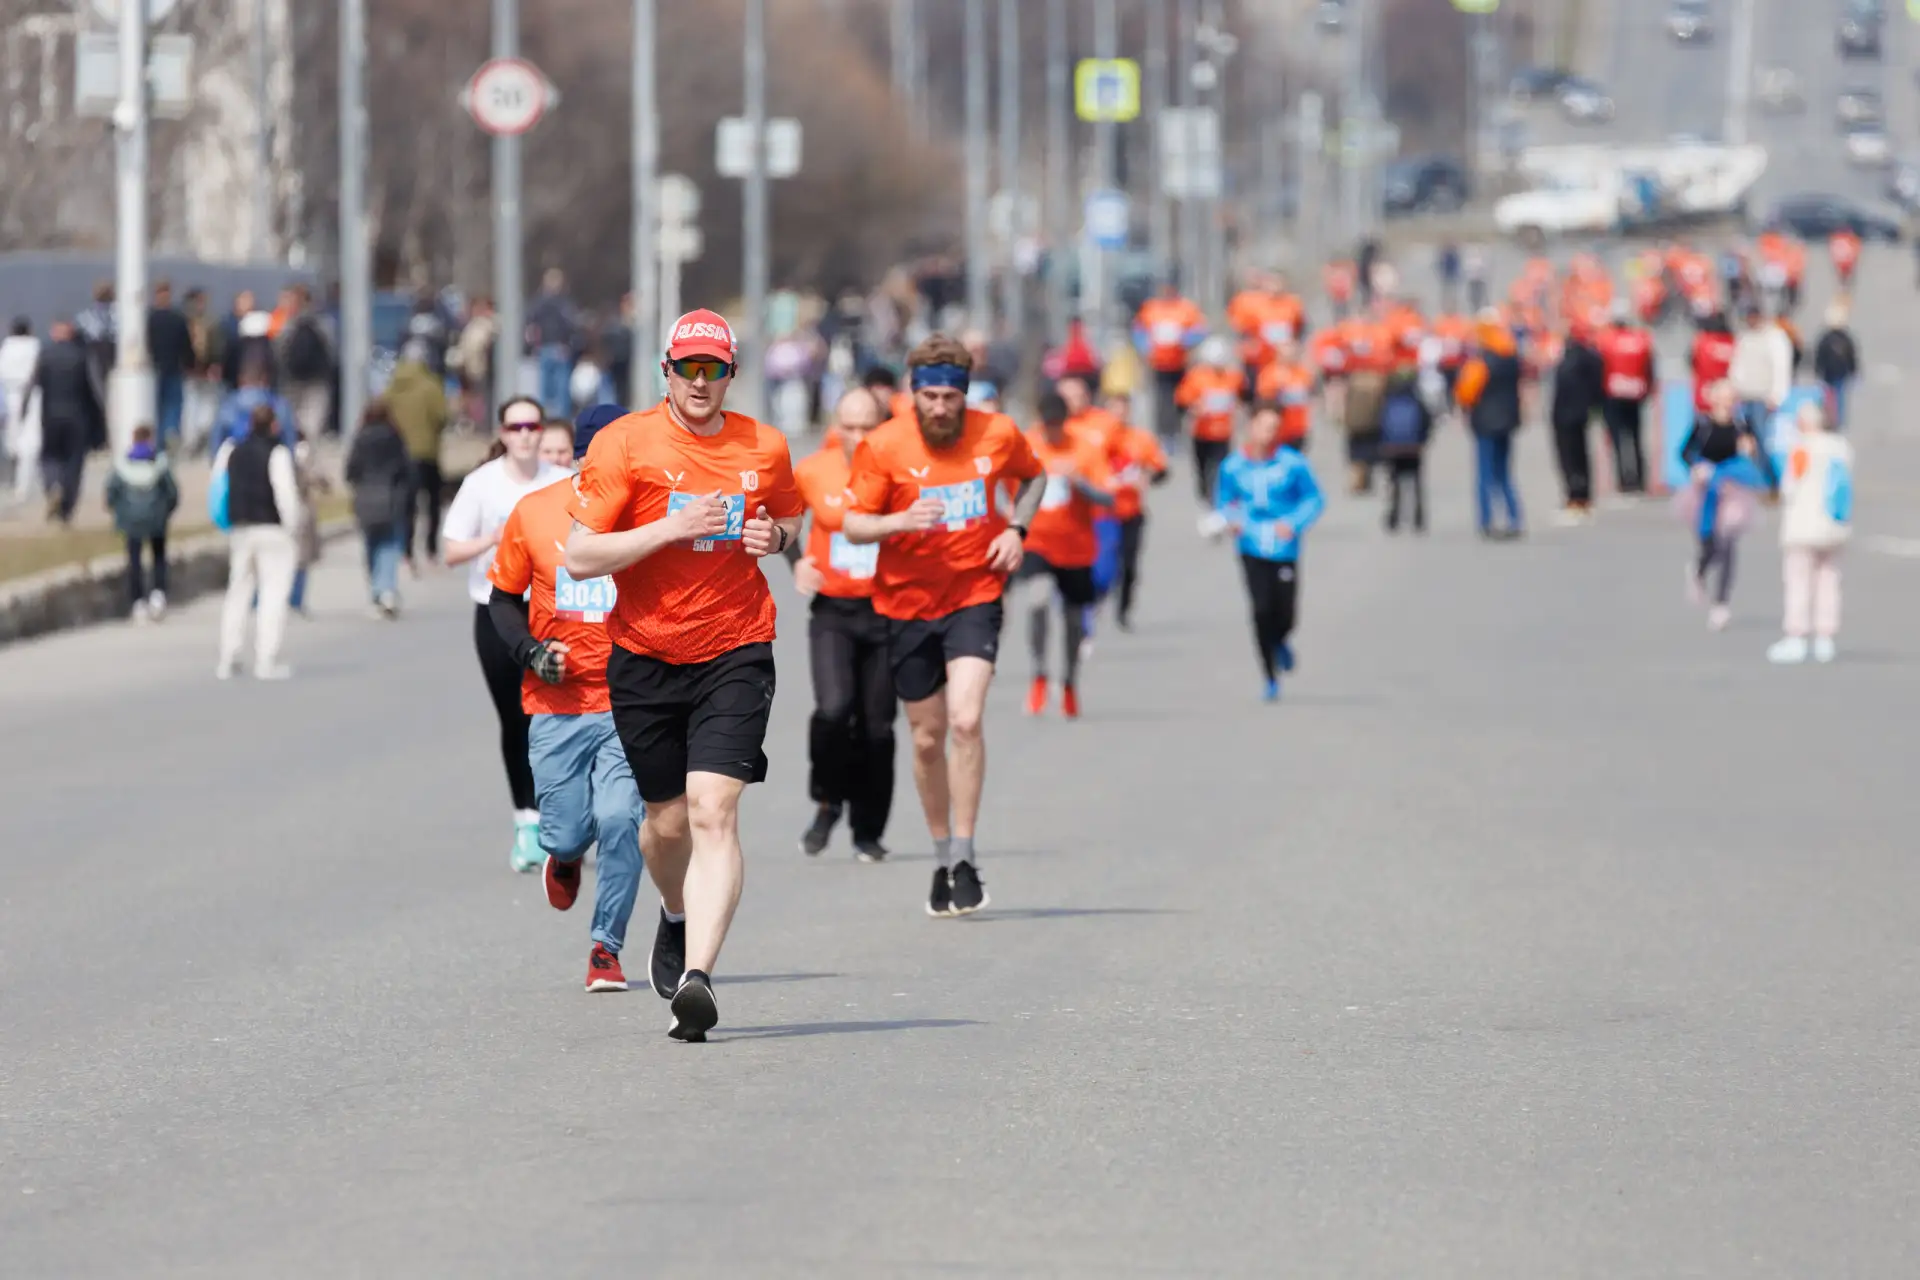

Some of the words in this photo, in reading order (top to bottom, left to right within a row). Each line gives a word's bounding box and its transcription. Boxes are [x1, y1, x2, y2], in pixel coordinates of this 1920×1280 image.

[674, 322, 729, 343] RUSSIA
[739, 470, 759, 491] 10
[560, 582, 614, 608] 3041
